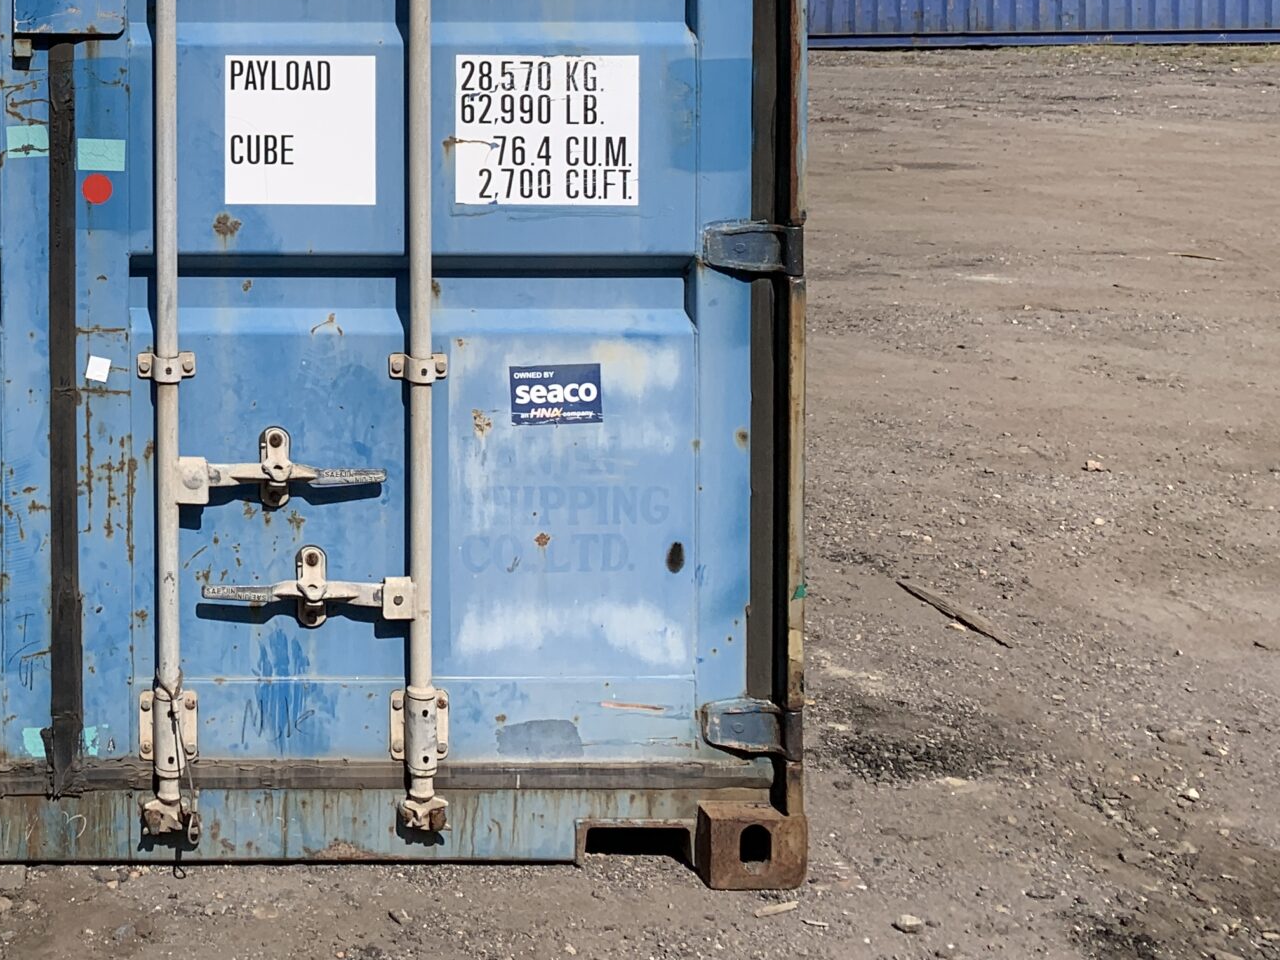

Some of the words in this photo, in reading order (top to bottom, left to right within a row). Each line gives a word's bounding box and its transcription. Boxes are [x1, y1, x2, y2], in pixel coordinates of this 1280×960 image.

[230, 60, 331, 91] PAYLOAD
[461, 61, 551, 92] 28,570
[566, 62, 604, 92] KG.
[461, 94, 551, 125] 62,990
[566, 95, 604, 125] LB.
[230, 135, 294, 165] CUBE
[493, 136, 552, 167] 76.4
[566, 136, 633, 167] CU.M.
[479, 168, 551, 199] 2,700
[543, 371, 555, 379] BY
[515, 382, 598, 405] seaco
